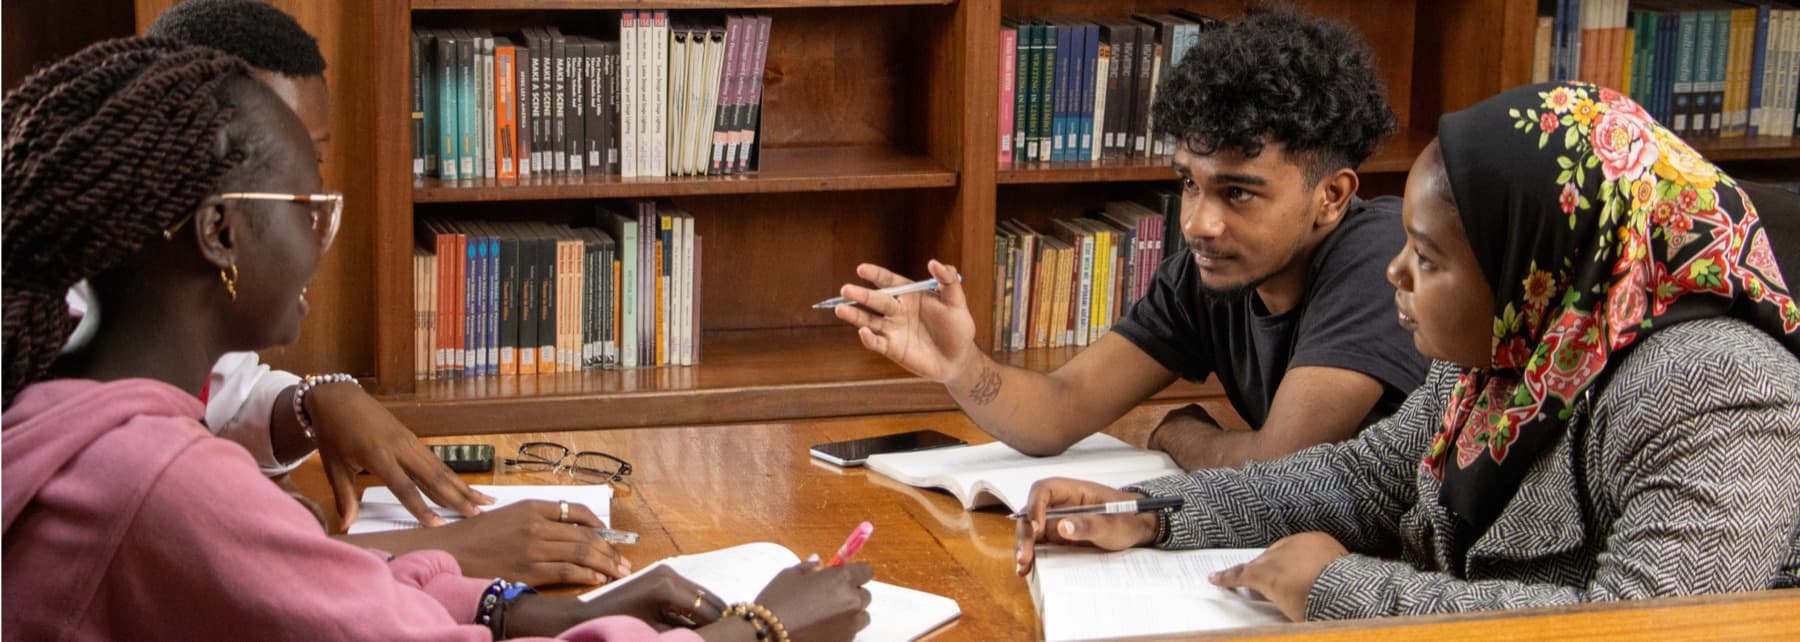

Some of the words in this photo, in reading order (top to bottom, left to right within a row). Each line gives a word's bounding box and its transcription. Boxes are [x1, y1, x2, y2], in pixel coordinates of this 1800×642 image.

[1680, 24, 1693, 80] multimedia
[1699, 24, 1711, 80] multimedia
[1716, 24, 1728, 80] multimedia
[532, 59, 540, 81] MAKE
[544, 58, 552, 80] MAKE
[556, 59, 564, 81] MAKE
[1019, 54, 1027, 92] WRITING
[1032, 54, 1041, 93] WRITING
[1046, 53, 1055, 92] WRITING
[532, 93, 540, 117] SCENE
[544, 92, 552, 116] SCENE
[556, 93, 564, 117] SCENE
[1018, 94, 1024, 102] IN
[1031, 94, 1037, 102] IN
[1045, 94, 1051, 102] IN
[1083, 272, 1089, 280] ME
